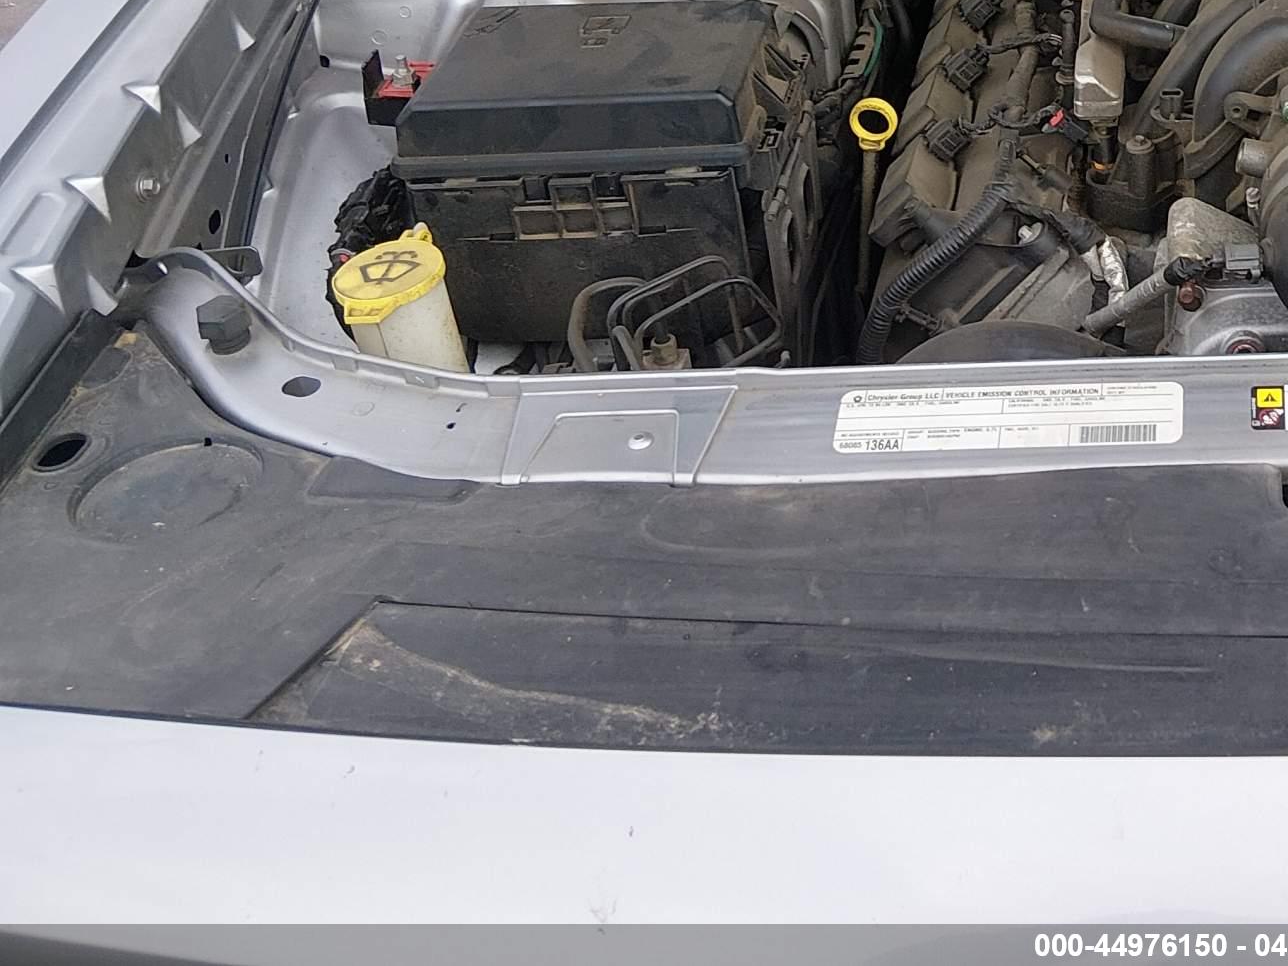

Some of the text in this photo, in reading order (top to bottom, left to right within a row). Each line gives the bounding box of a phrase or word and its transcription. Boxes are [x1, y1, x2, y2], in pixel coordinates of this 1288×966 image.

[867, 392, 940, 402] Chrysler Group LLC
[945, 391, 975, 399] VEHICLE
[978, 390, 1012, 398] EMISSION
[1049, 388, 1099, 396] INFORMATION
[865, 439, 900, 451] 136AA
